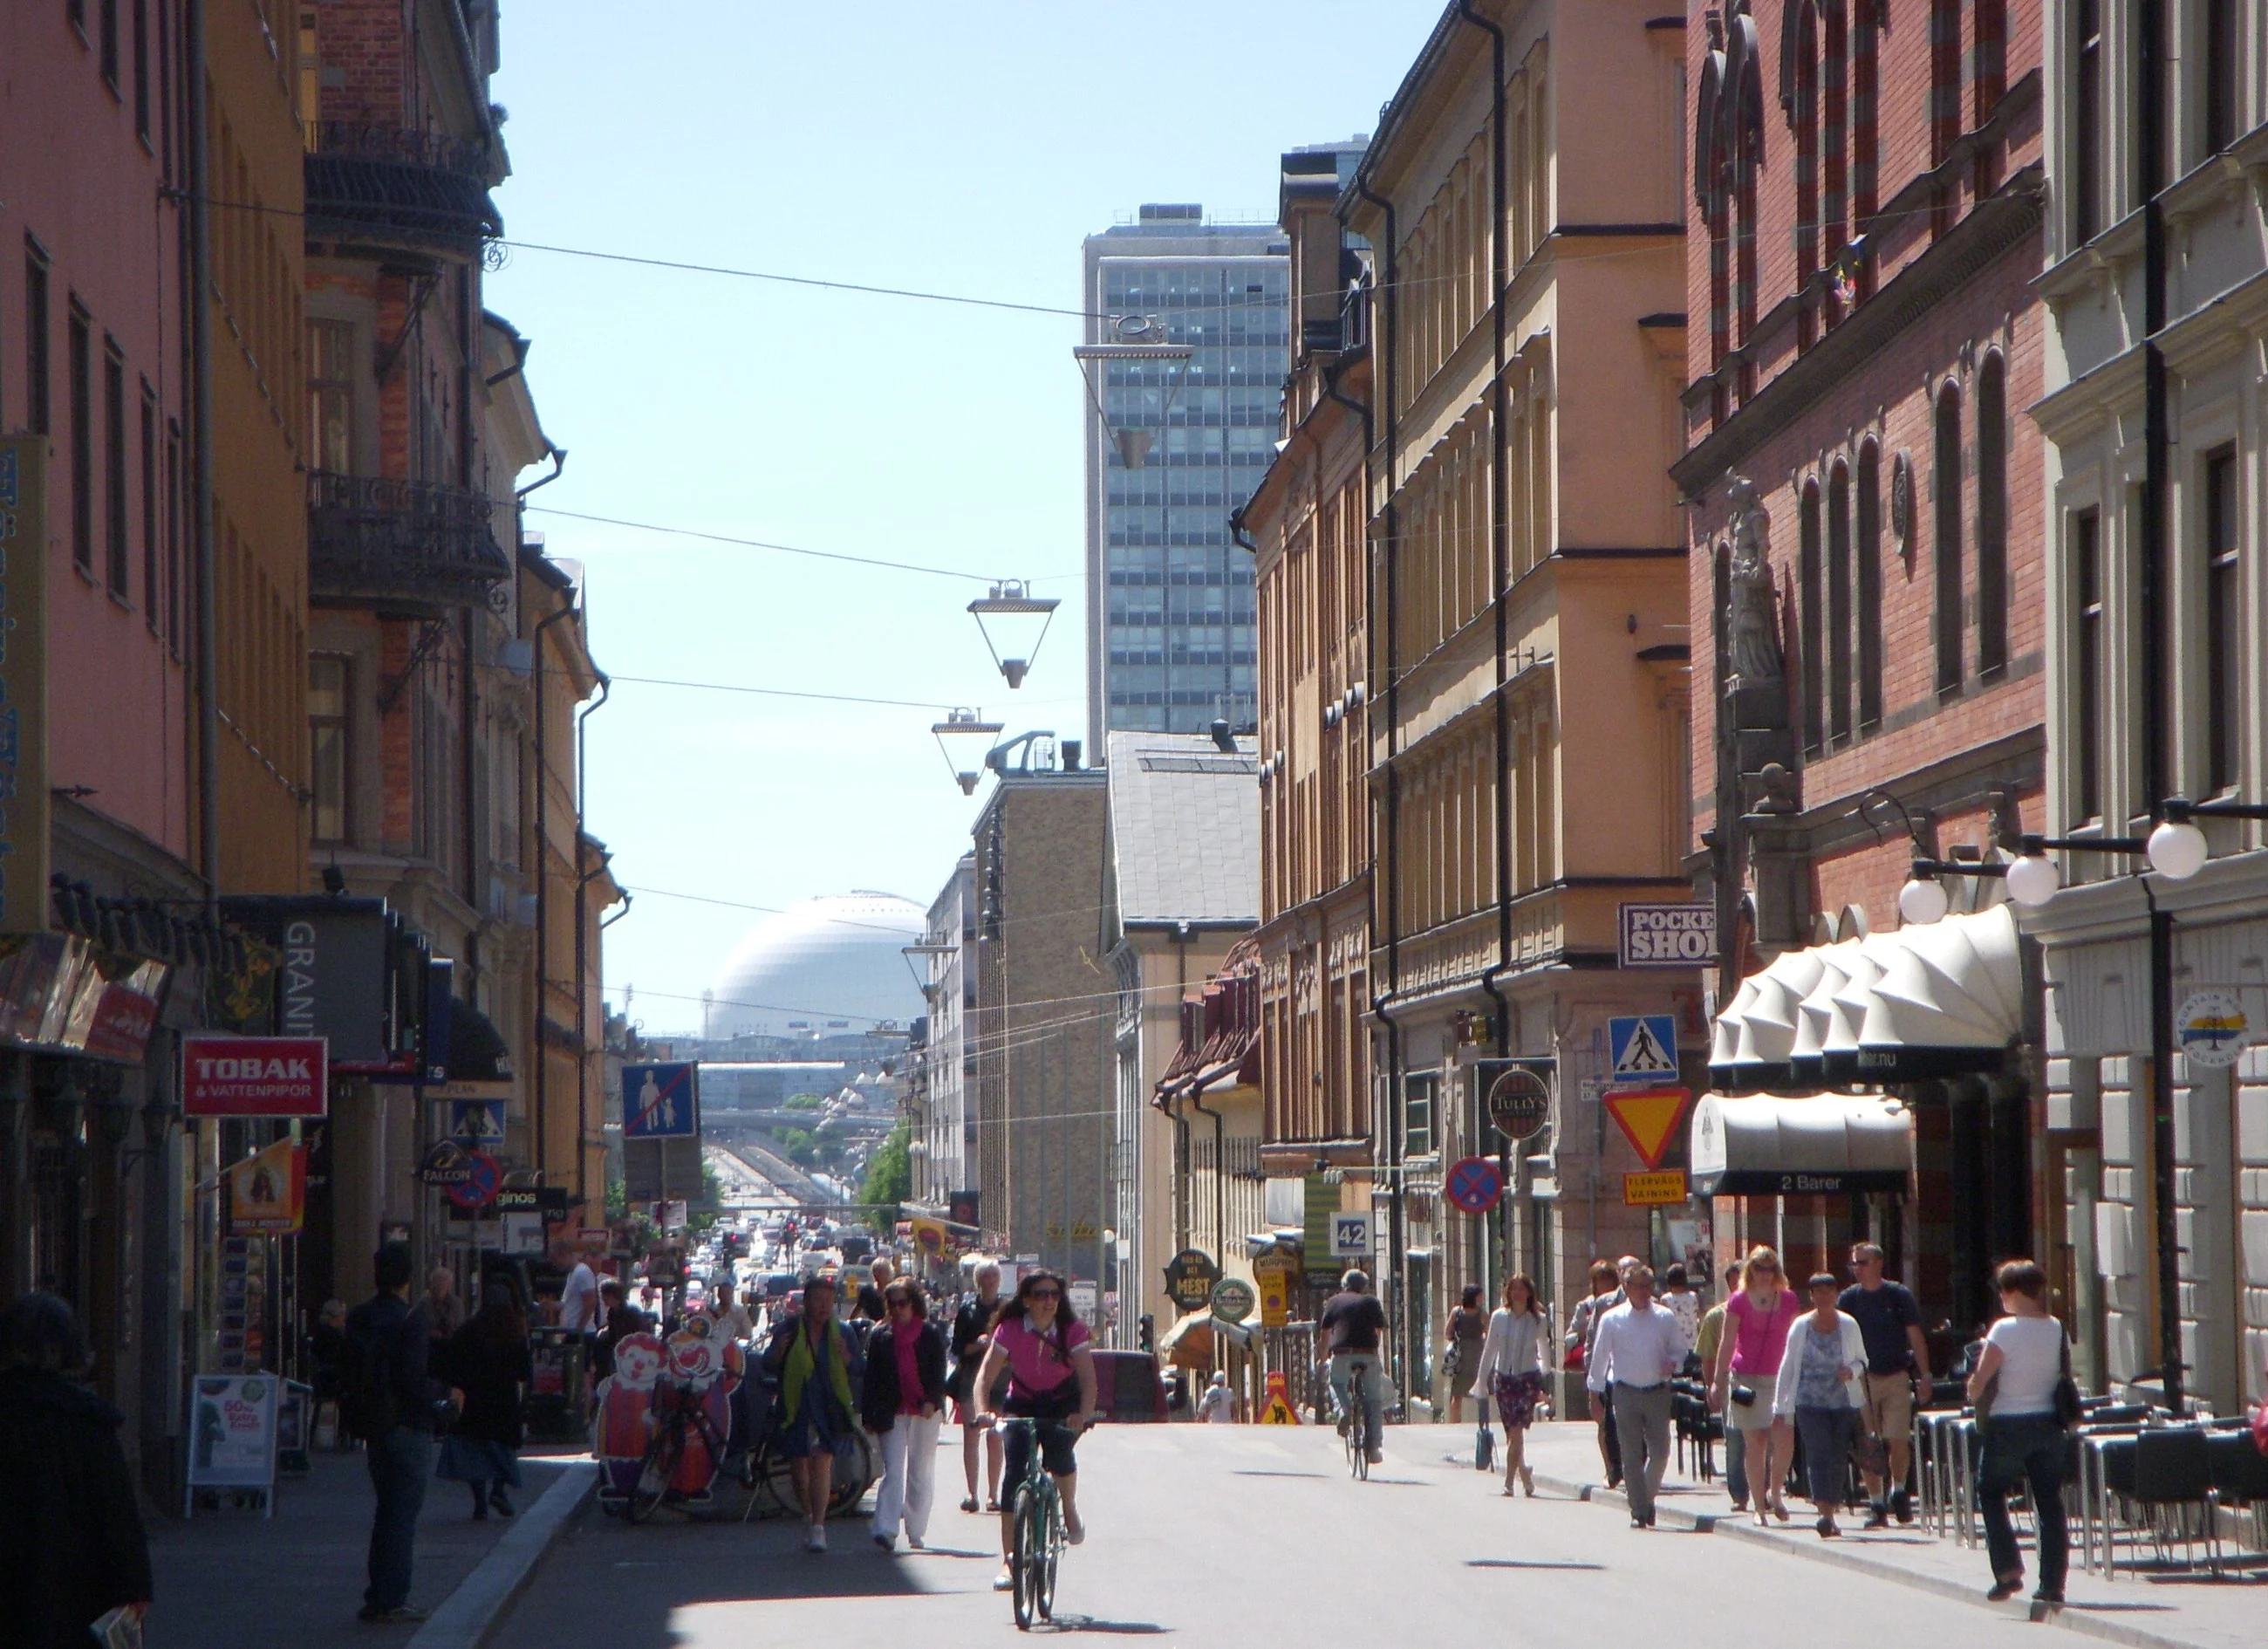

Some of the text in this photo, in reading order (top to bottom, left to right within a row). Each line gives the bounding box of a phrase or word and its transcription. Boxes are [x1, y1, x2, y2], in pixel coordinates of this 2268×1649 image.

[1632, 911, 1714, 930] POCKE
[285, 920, 317, 1037] GRANI
[196, 1057, 312, 1080] TOBAK
[195, 1085, 312, 1098] & VATTENPIPOR
[423, 1169, 471, 1181] FALCON
[1781, 1175, 1842, 1190] 2 Barer
[495, 1189, 537, 1207] ginos
[1339, 1224, 1366, 1245] 42
[1176, 1277, 1211, 1295] MEST
